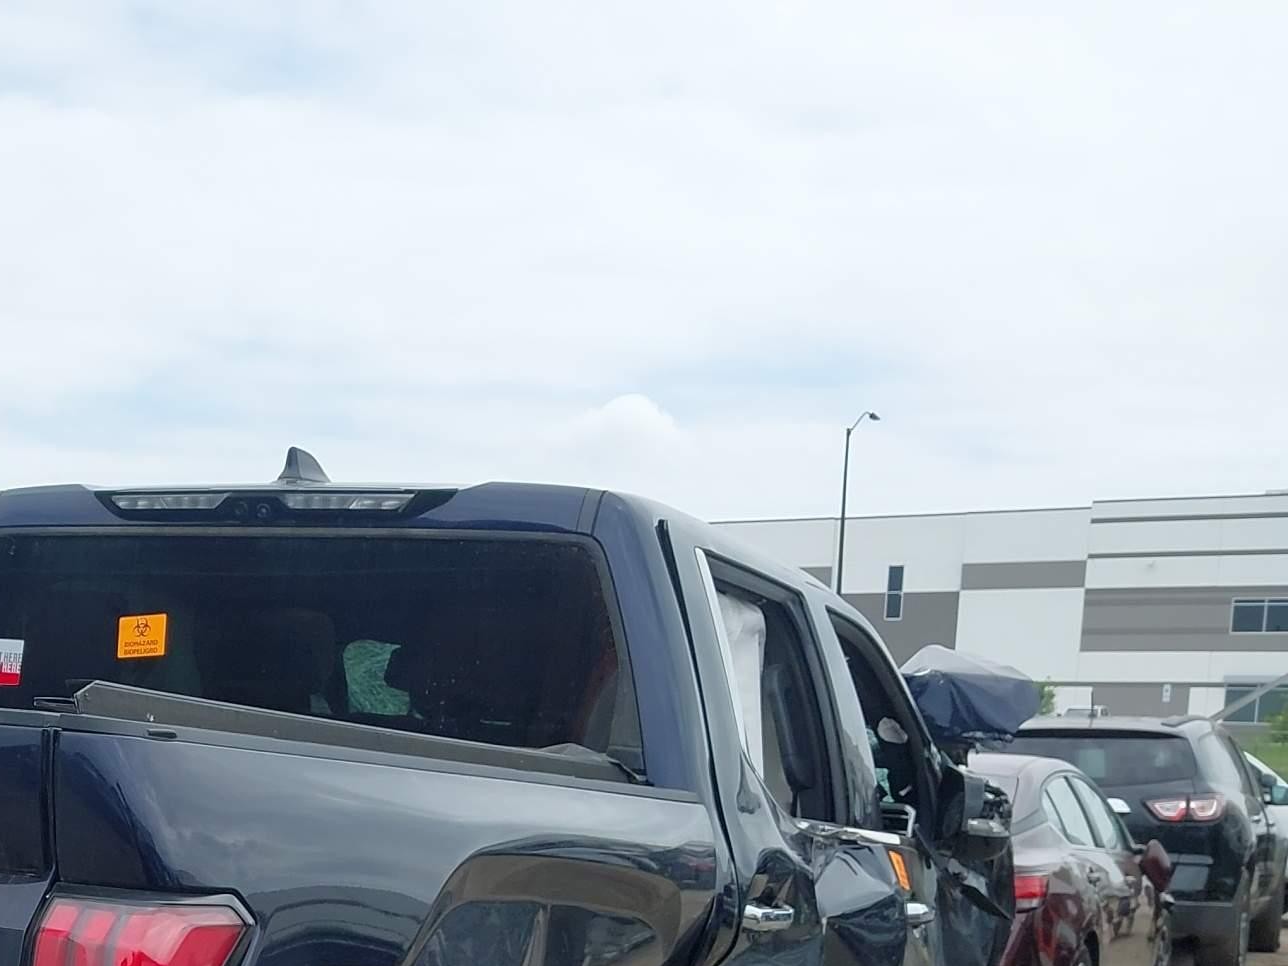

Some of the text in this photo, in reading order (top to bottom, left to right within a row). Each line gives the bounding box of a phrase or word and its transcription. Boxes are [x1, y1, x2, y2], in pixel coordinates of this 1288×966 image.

[123, 639, 159, 648] BIOHAZARD
[123, 647, 158, 655] BIOPELIGRO
[4, 651, 23, 663] HERE
[2, 660, 22, 674] HERE
